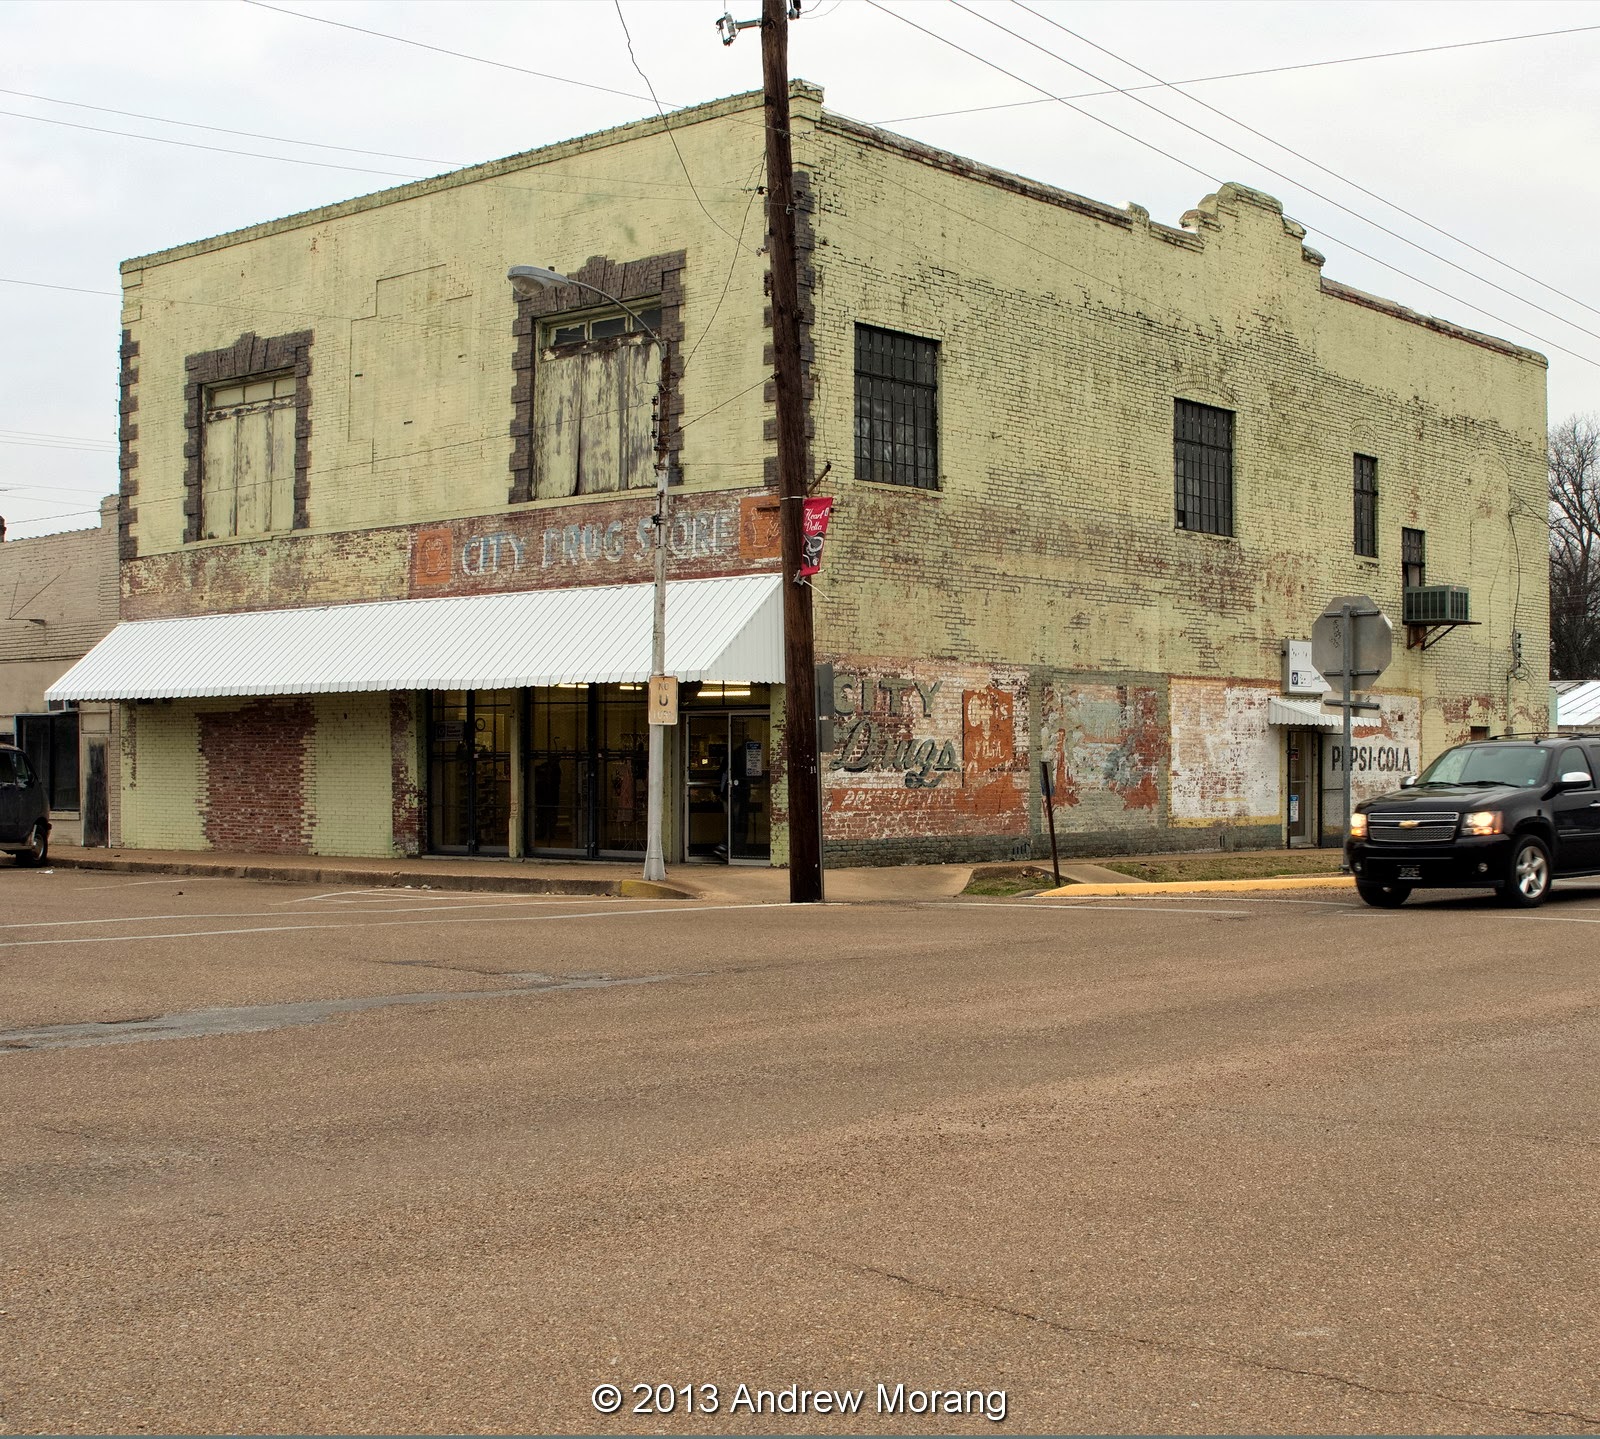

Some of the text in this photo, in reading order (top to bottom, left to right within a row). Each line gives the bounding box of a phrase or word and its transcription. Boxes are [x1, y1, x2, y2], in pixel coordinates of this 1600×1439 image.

[462, 532, 526, 576] CITY
[635, 513, 733, 563] SORE
[659, 694, 669, 707] U
[832, 674, 944, 719] CITY
[829, 717, 961, 789] Drugs
[1331, 745, 1411, 772] PPSI-COLA
